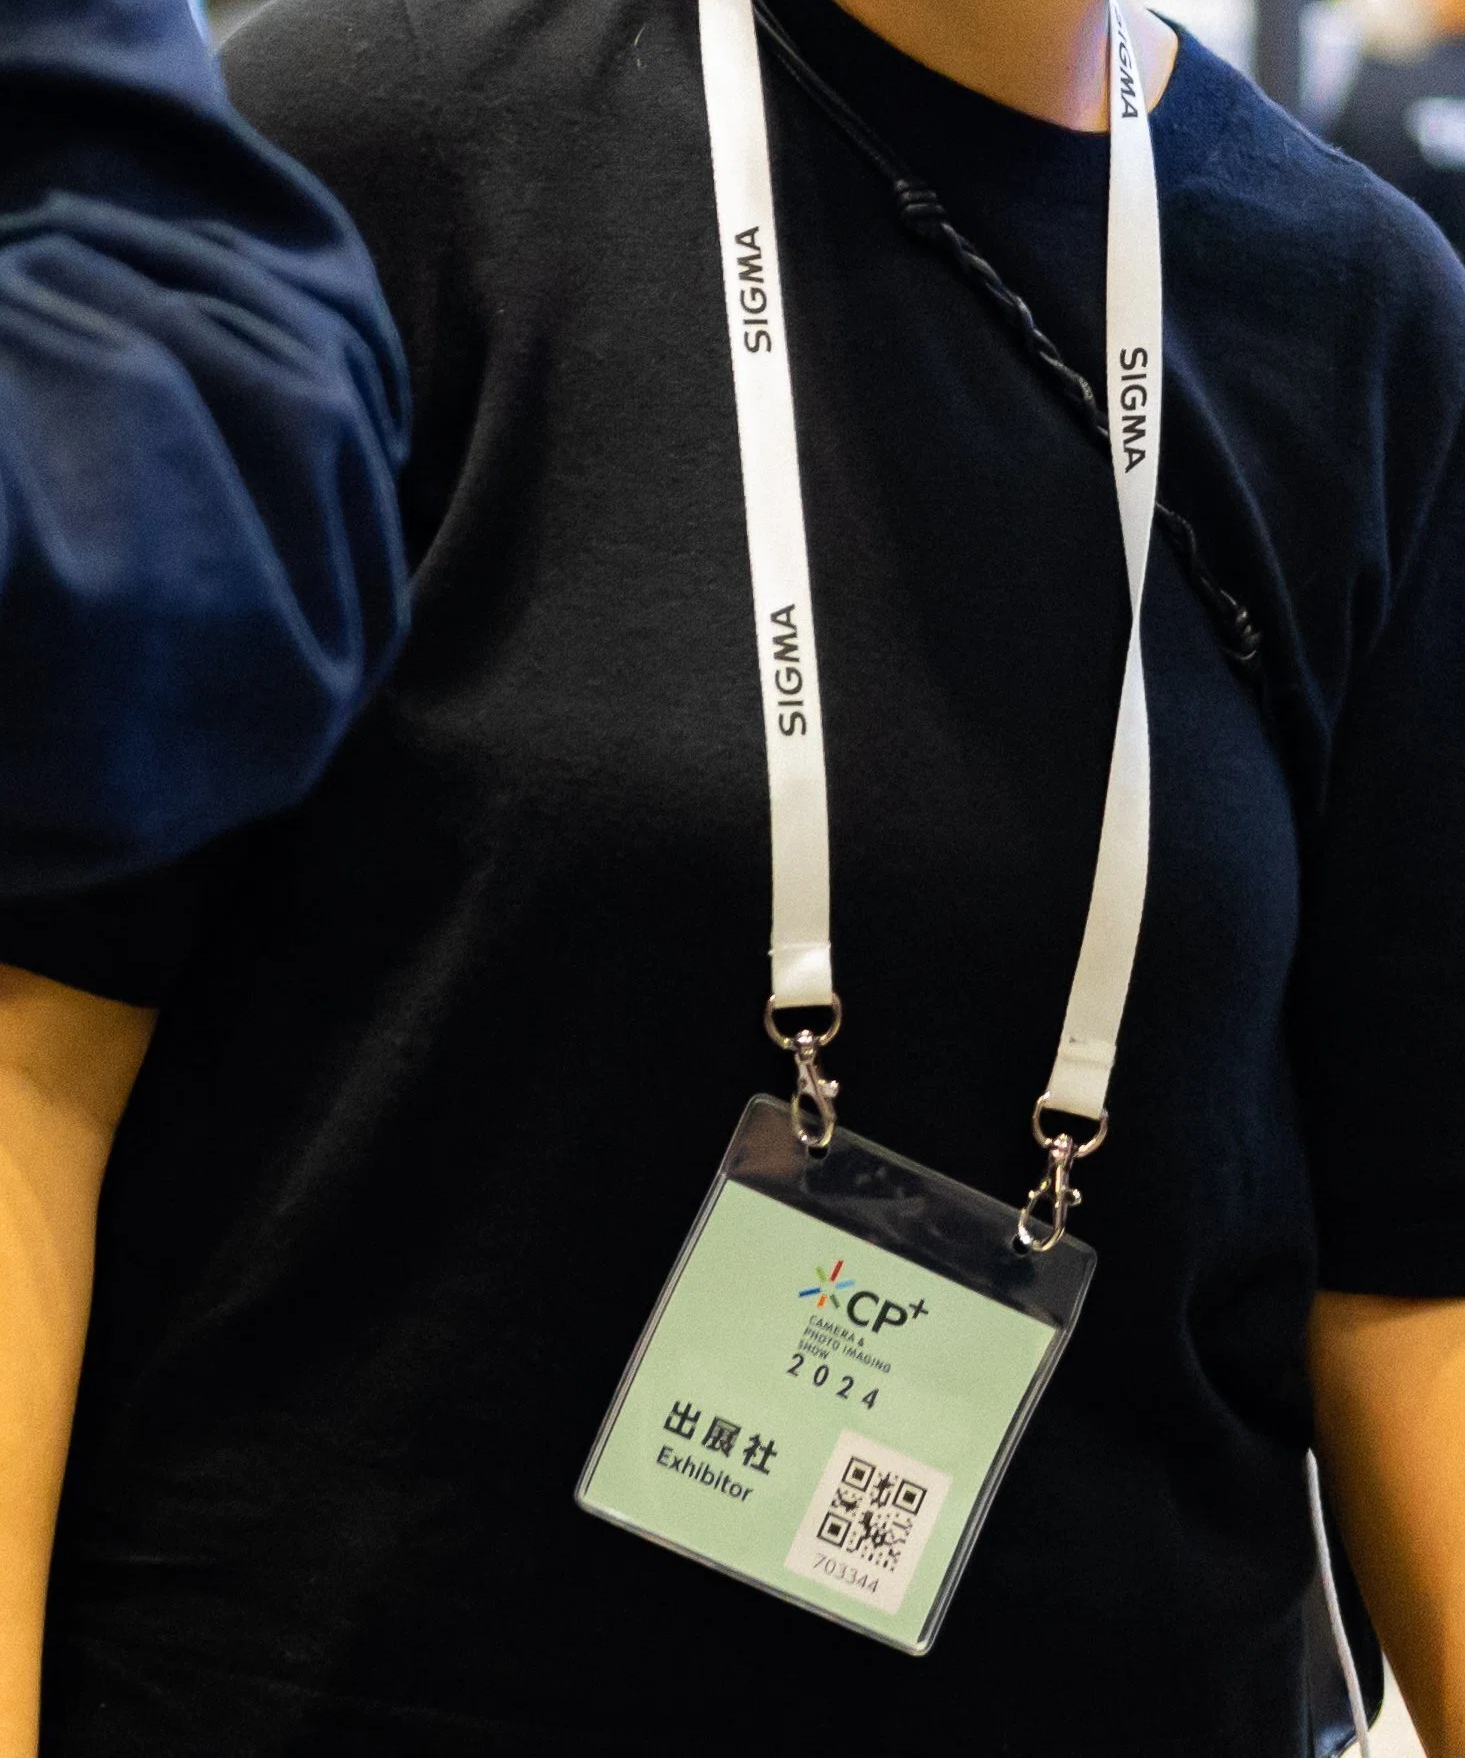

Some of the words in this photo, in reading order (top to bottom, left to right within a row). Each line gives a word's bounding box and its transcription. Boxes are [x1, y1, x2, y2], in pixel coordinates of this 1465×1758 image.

[734, 226, 772, 353] SIGMA
[1120, 347, 1148, 474] SIGMA
[770, 603, 807, 736] SIGMA
[808, 1315, 855, 1344] CAMERA
[846, 1290, 929, 1334] CP+
[798, 1340, 831, 1361] SHOW
[803, 1326, 841, 1352] PHOTO
[842, 1345, 893, 1374] IMAGING
[786, 1352, 880, 1411] 2024
[663, 1400, 778, 1476] 出展社
[656, 1444, 755, 1502] Exhibitor
[813, 1551, 880, 1595] 703344
